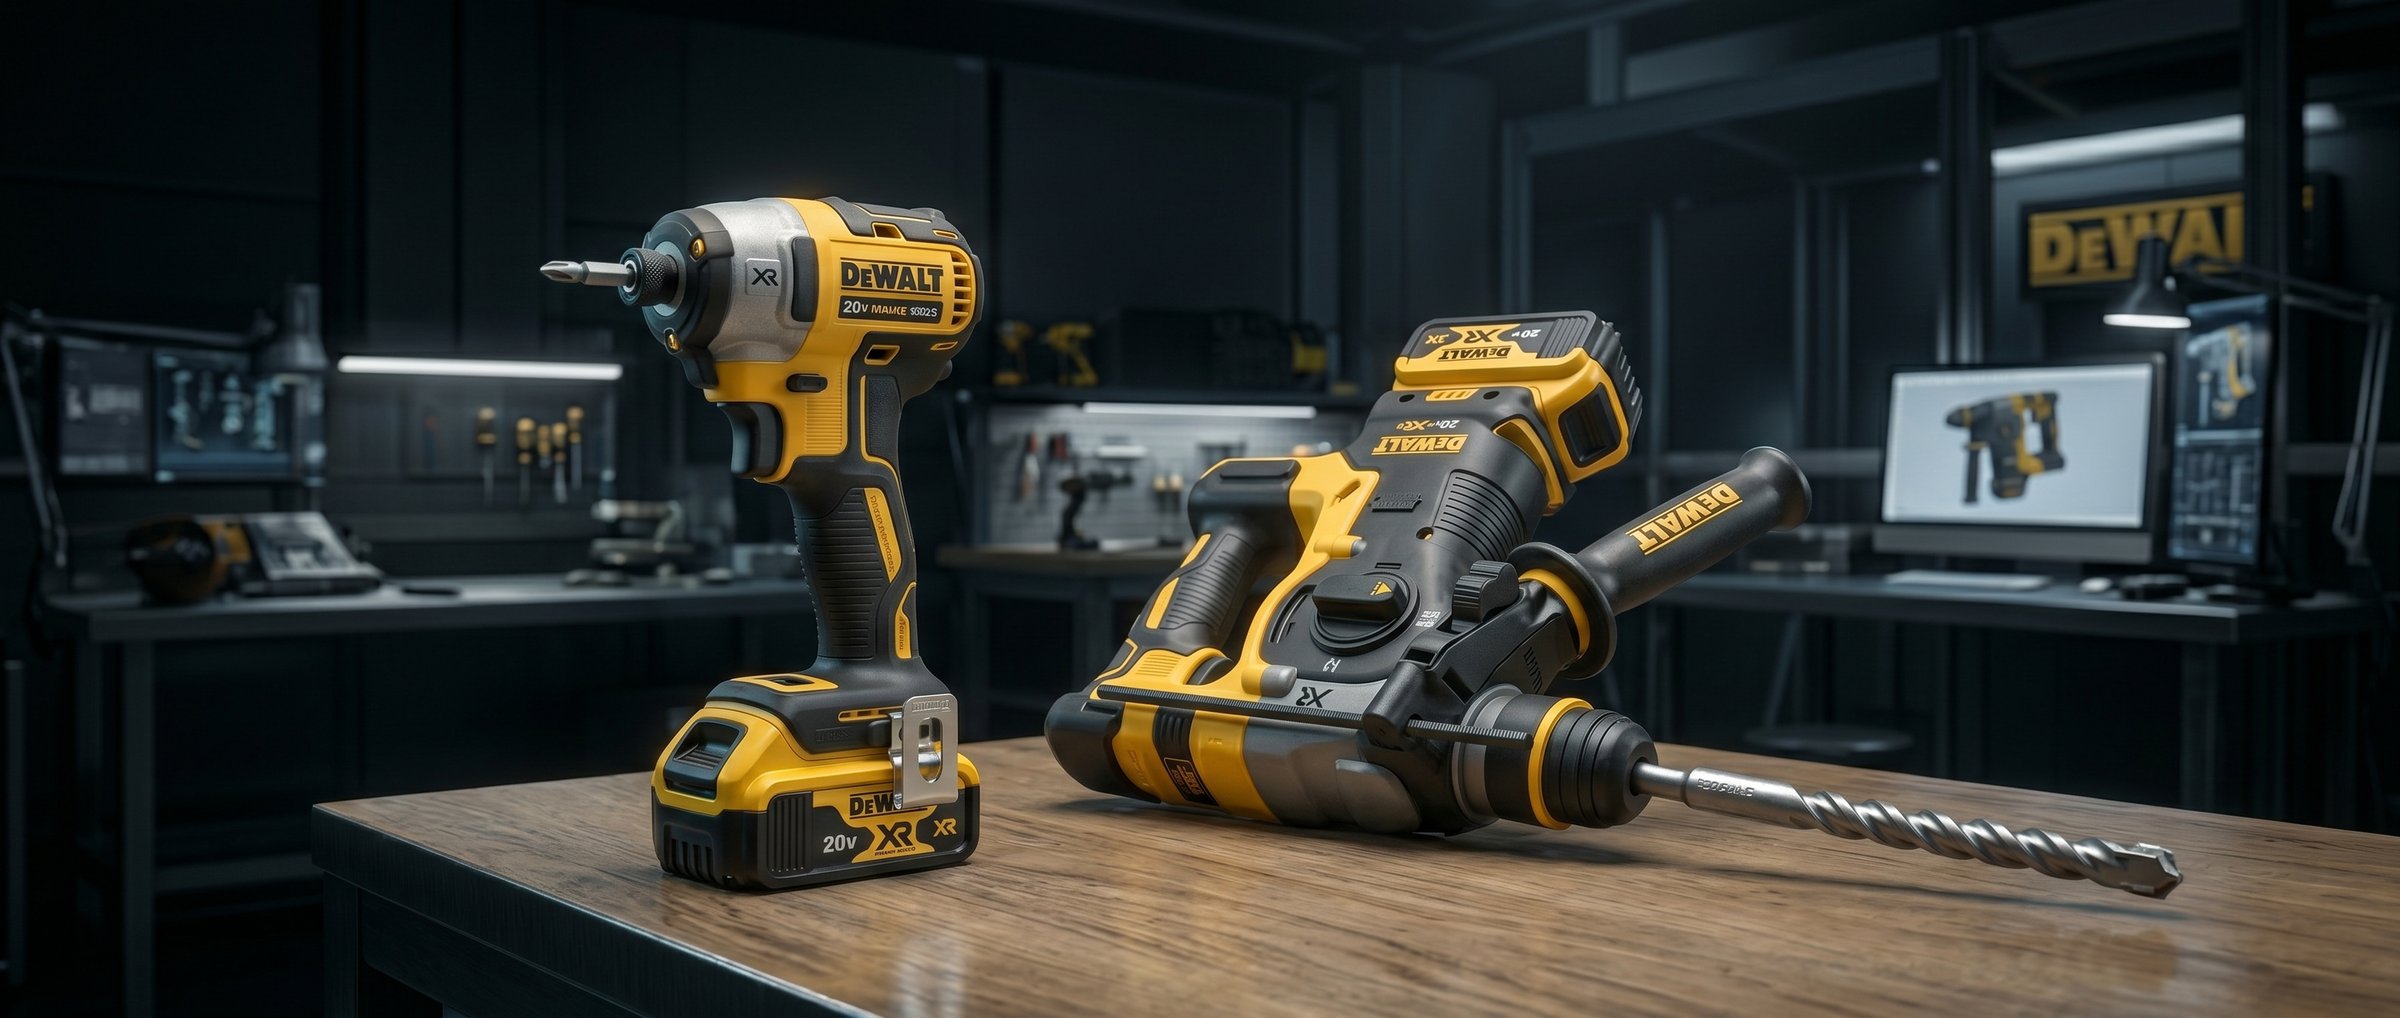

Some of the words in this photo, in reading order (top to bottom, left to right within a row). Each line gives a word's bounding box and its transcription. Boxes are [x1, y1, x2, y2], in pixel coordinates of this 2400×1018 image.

[752, 268, 778, 286] XR
[876, 821, 914, 851] XR
[933, 818, 957, 838] XR
